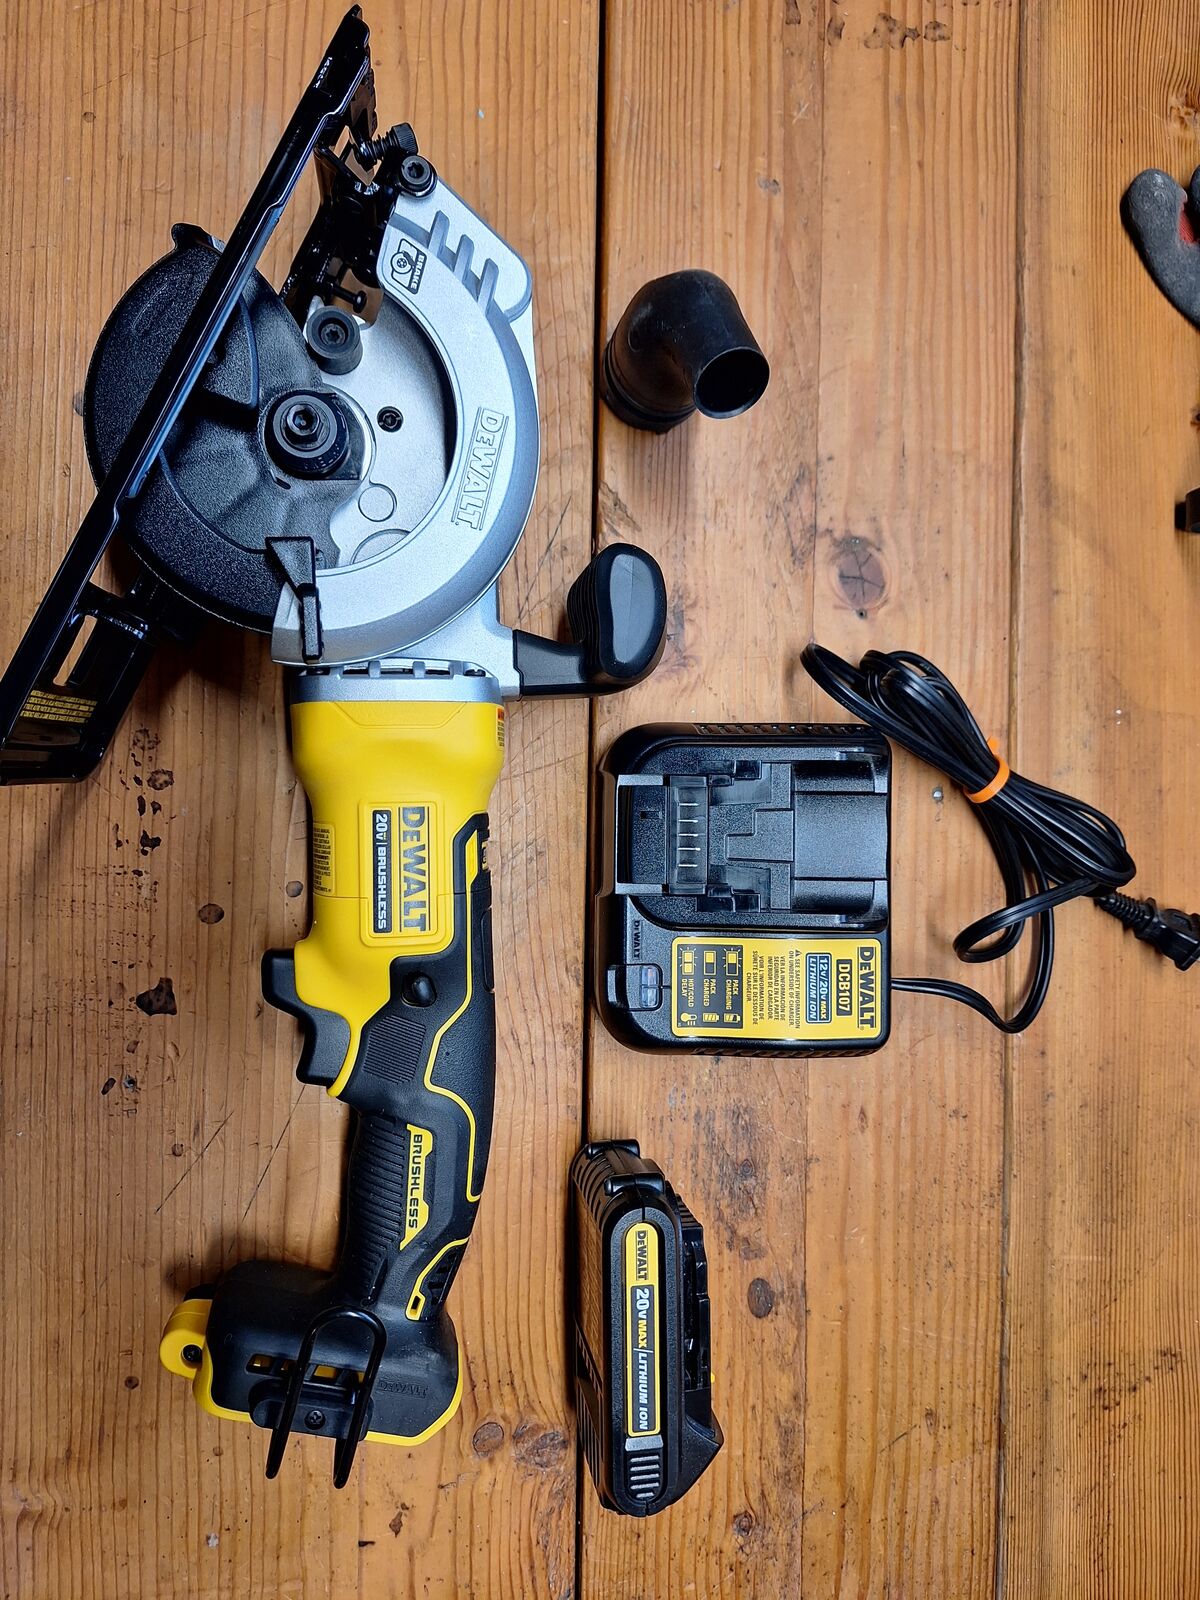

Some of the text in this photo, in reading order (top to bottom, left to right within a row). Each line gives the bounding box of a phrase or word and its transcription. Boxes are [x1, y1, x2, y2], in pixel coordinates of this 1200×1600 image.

[411, 254, 425, 290] BRAKE
[456, 408, 505, 530] DEWALT
[377, 846, 387, 930] BRUSHLESS
[402, 806, 427, 932] DEWALT
[789, 951, 795, 959] ON
[809, 957, 817, 998] LITHIUM
[789, 991, 795, 999] OF
[838, 963, 851, 1012] DCB107
[859, 946, 875, 1029] DEWALT
[408, 1134, 423, 1229] BRUSHLESS
[637, 1230, 647, 1281] DEWALT
[638, 1319, 647, 1349] MAX
[639, 1352, 648, 1405] LITHIUM
[639, 1407, 648, 1430] ION
